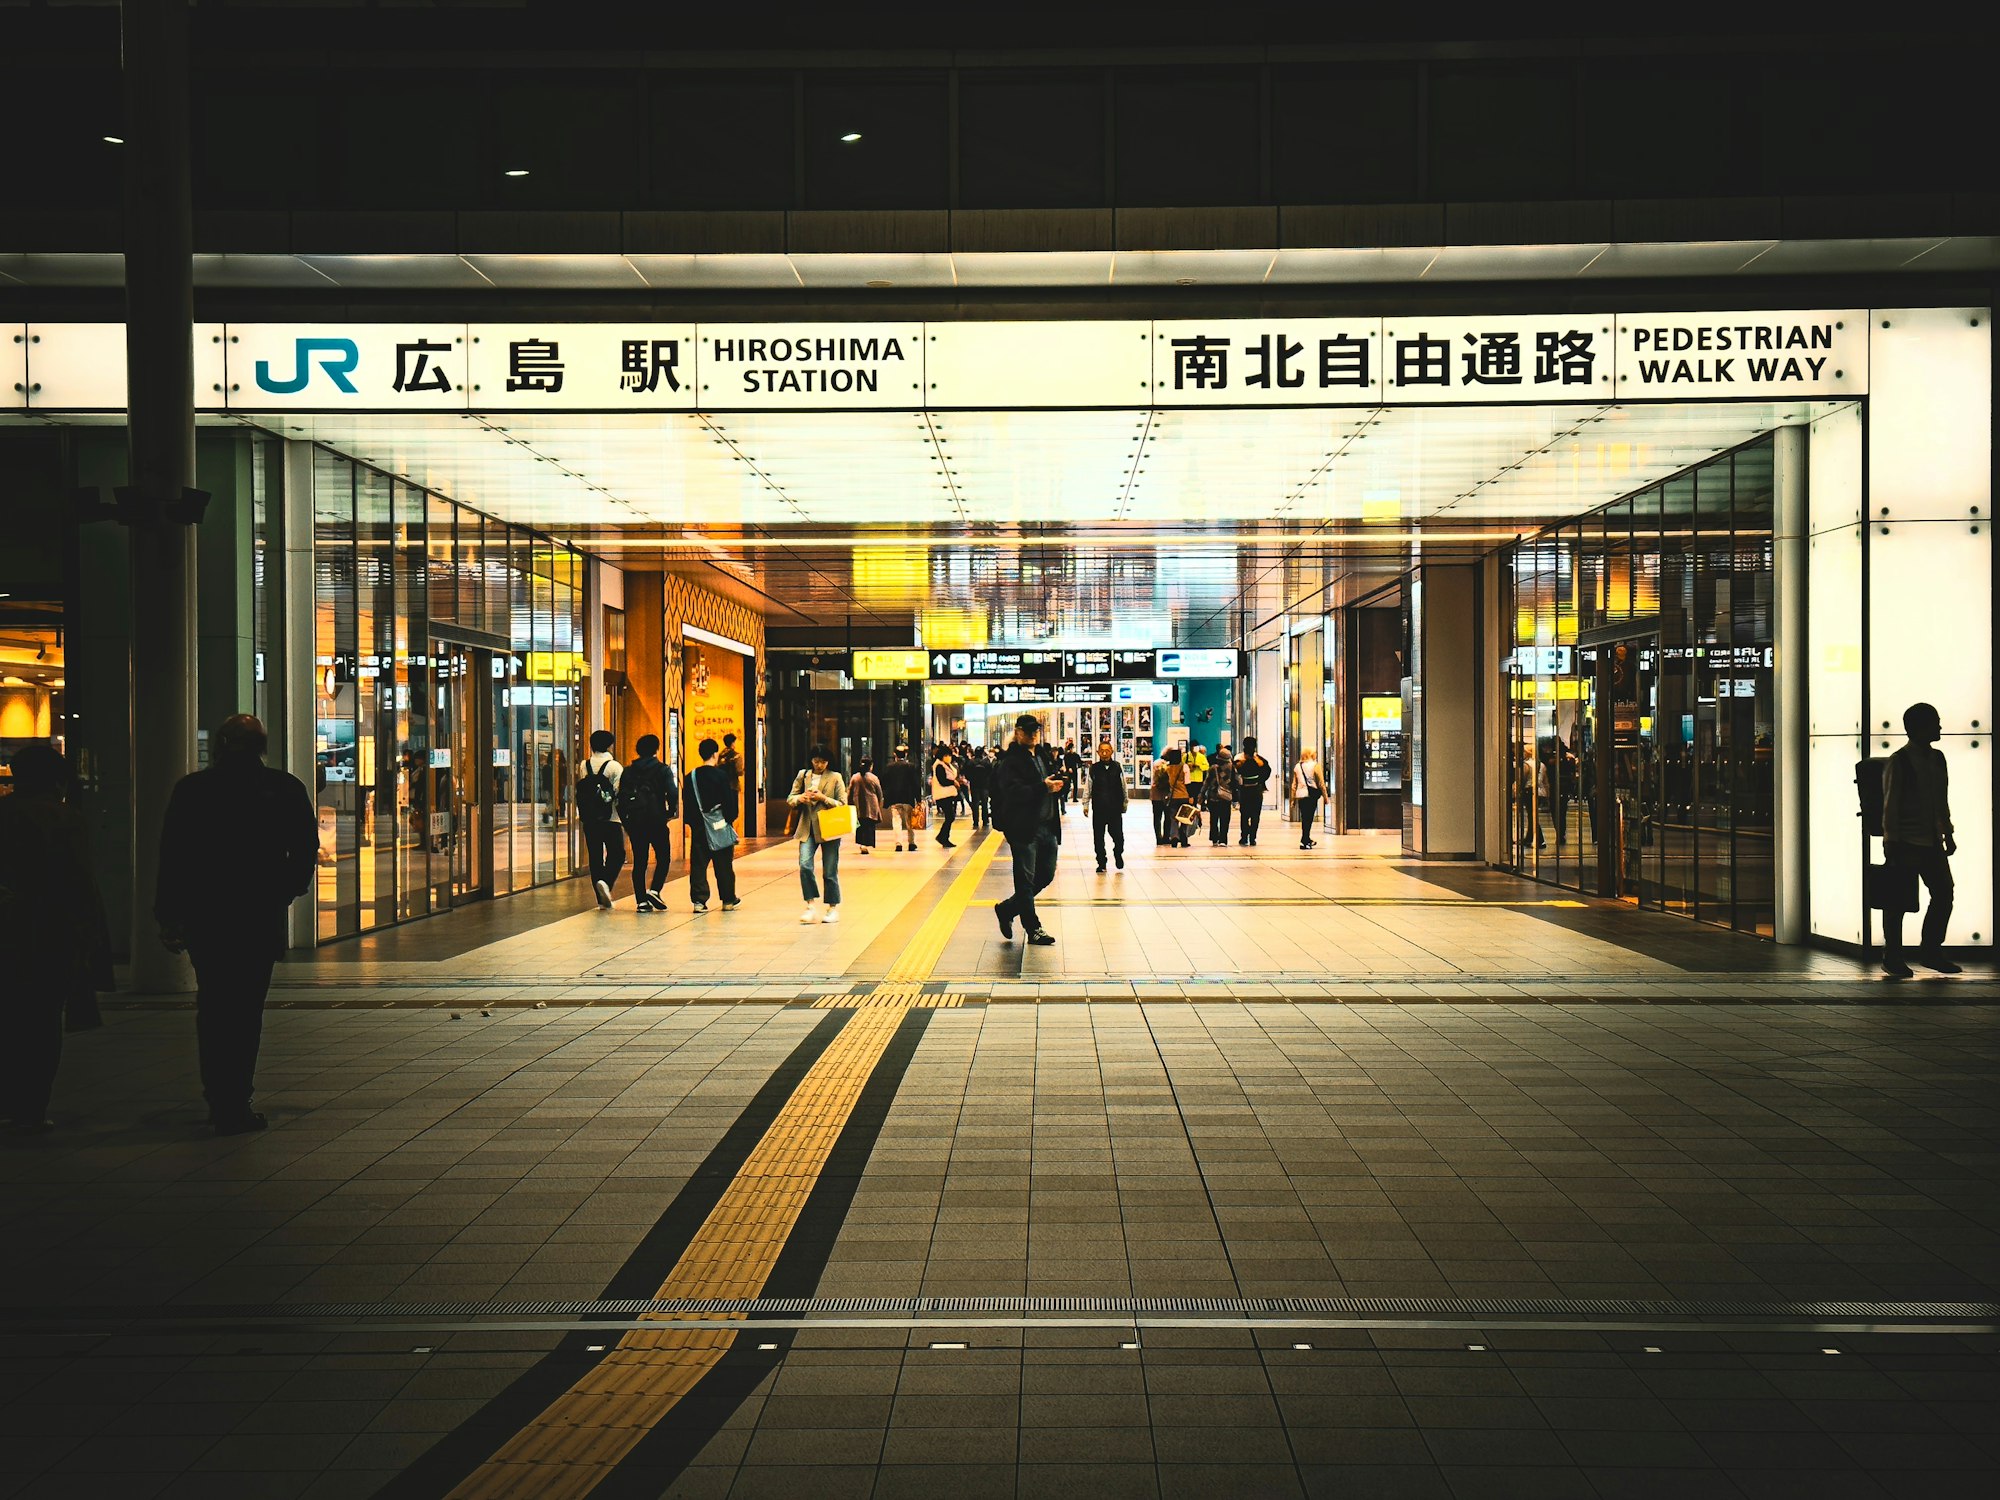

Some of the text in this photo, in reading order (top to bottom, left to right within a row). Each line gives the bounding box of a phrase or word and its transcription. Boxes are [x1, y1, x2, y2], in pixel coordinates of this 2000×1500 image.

[714, 338, 905, 362] HIROSHIMA
[1634, 325, 1832, 352] PEDESTRIAN
[255, 338, 681, 394] JR 広島駅
[1171, 330, 1596, 390] 南北自由通路
[1639, 357, 1827, 384] WALK WAY
[743, 369, 878, 393] STATION
